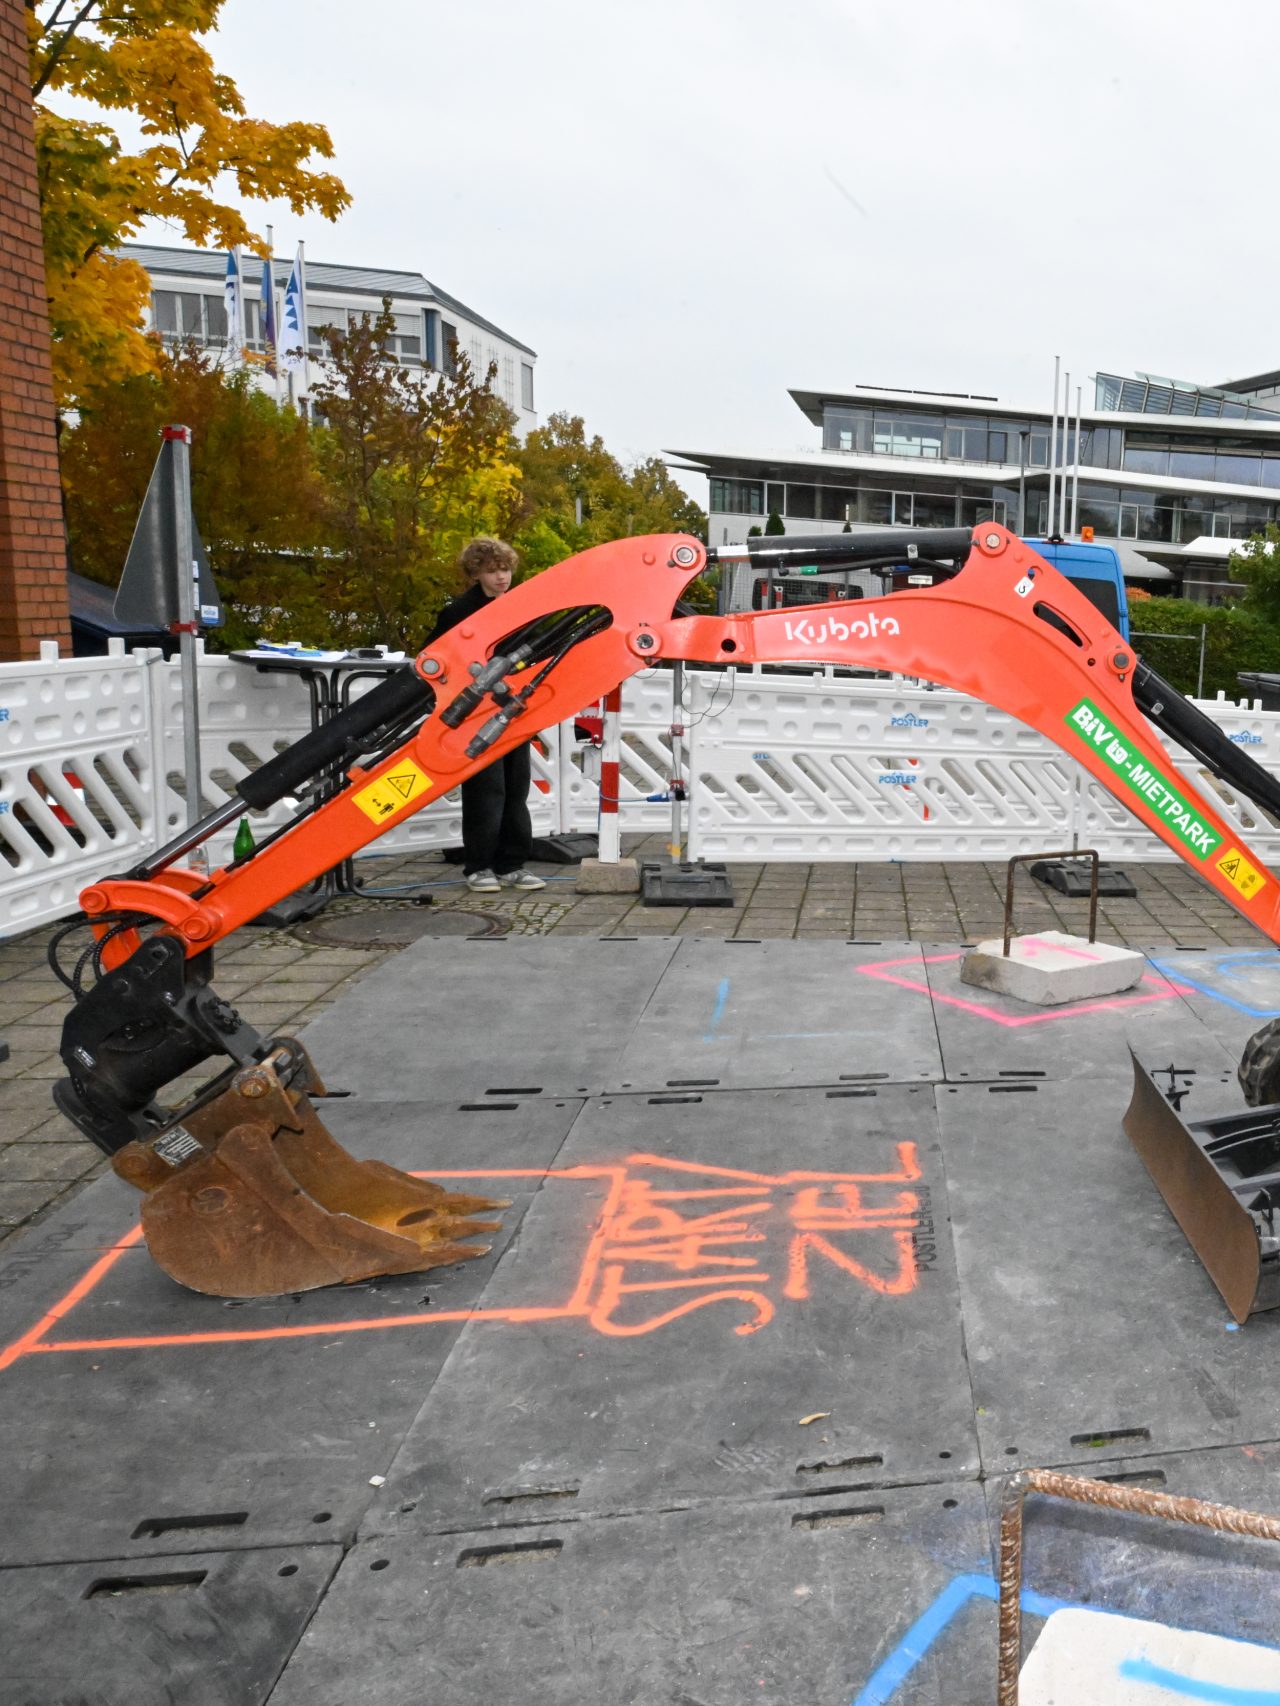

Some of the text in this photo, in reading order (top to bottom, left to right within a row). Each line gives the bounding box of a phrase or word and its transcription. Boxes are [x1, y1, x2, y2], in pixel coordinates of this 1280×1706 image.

[784, 612, 900, 645] Kubota
[891, 717, 929, 728] POSTLER
[878, 775, 917, 785] POSTLER
[784, 1141, 922, 1299] ZIEL
